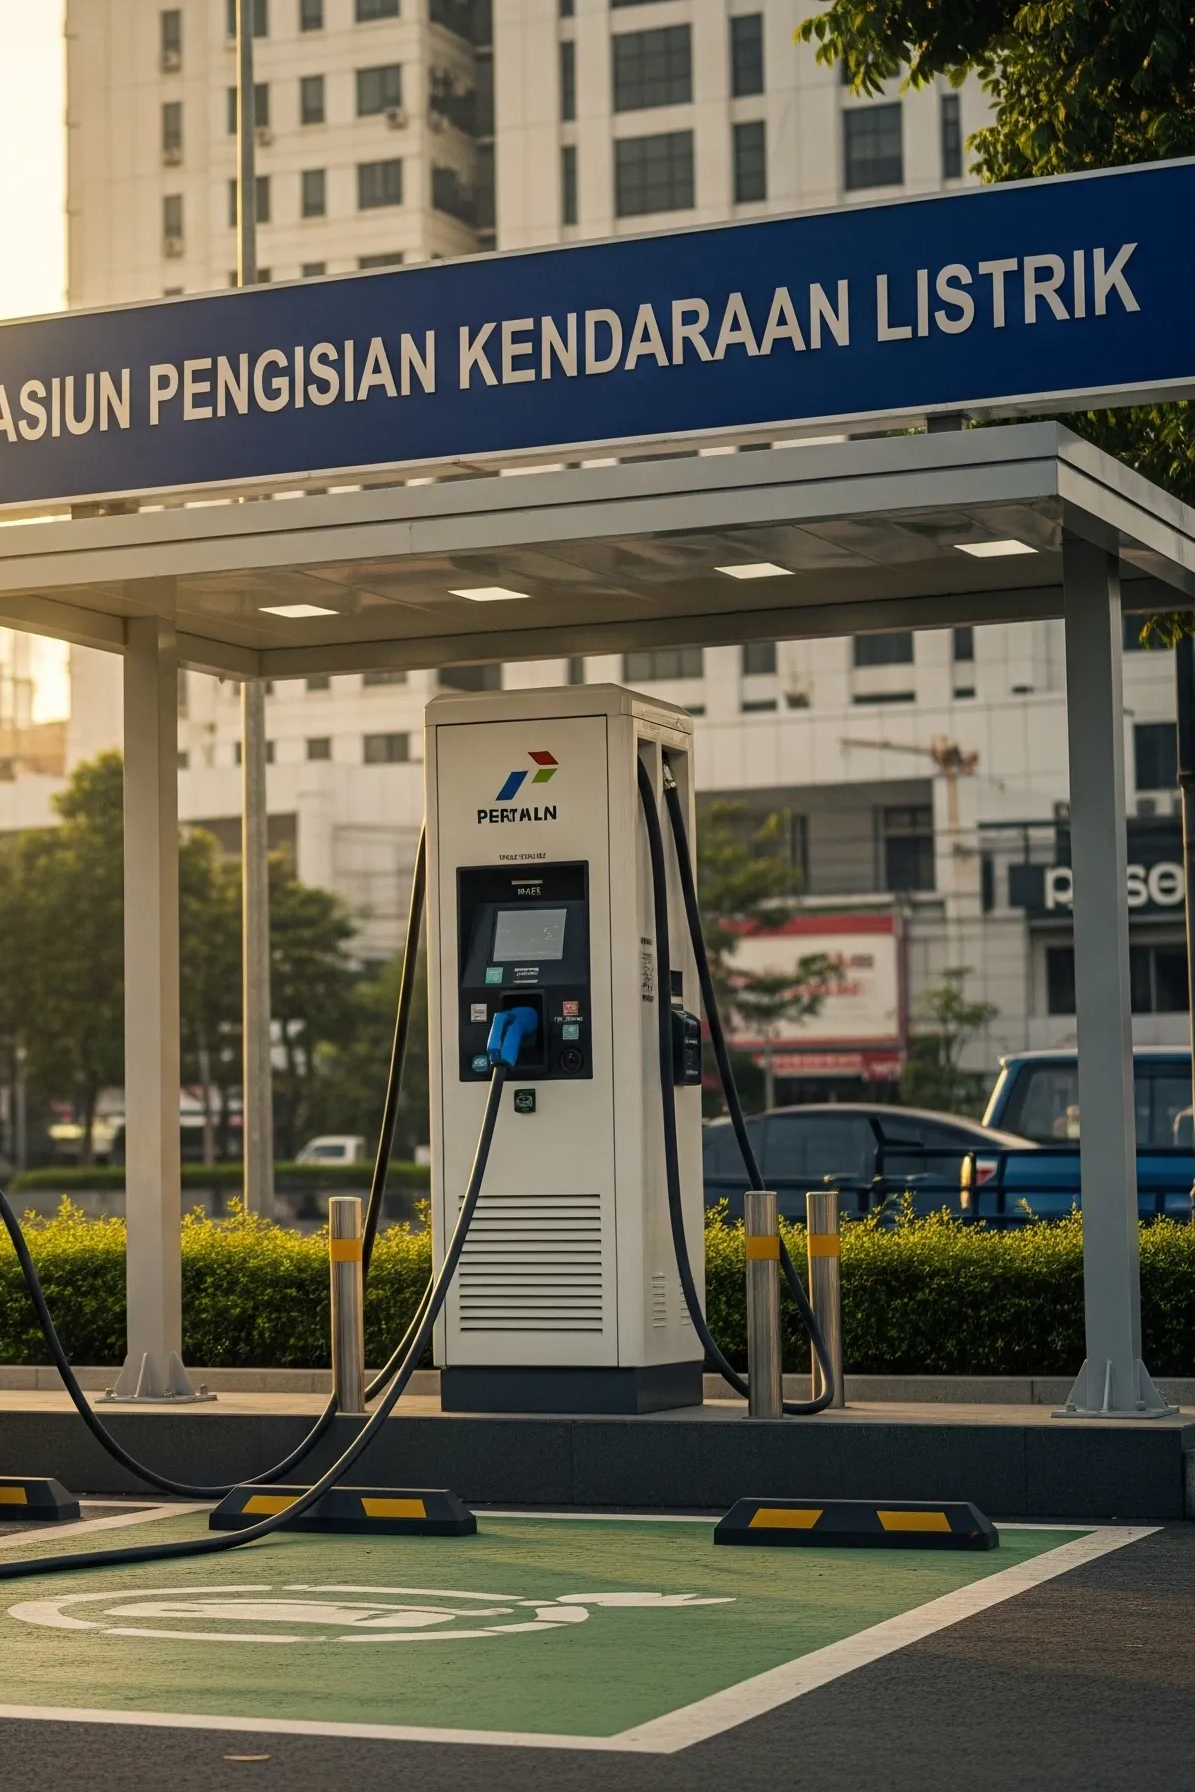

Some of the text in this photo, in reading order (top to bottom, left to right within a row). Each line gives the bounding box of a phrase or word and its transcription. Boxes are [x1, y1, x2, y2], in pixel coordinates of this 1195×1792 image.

[149, 331, 436, 426] PENGISIAN
[459, 280, 849, 389] KENDARAAN
[877, 243, 1141, 340] LISTRIK
